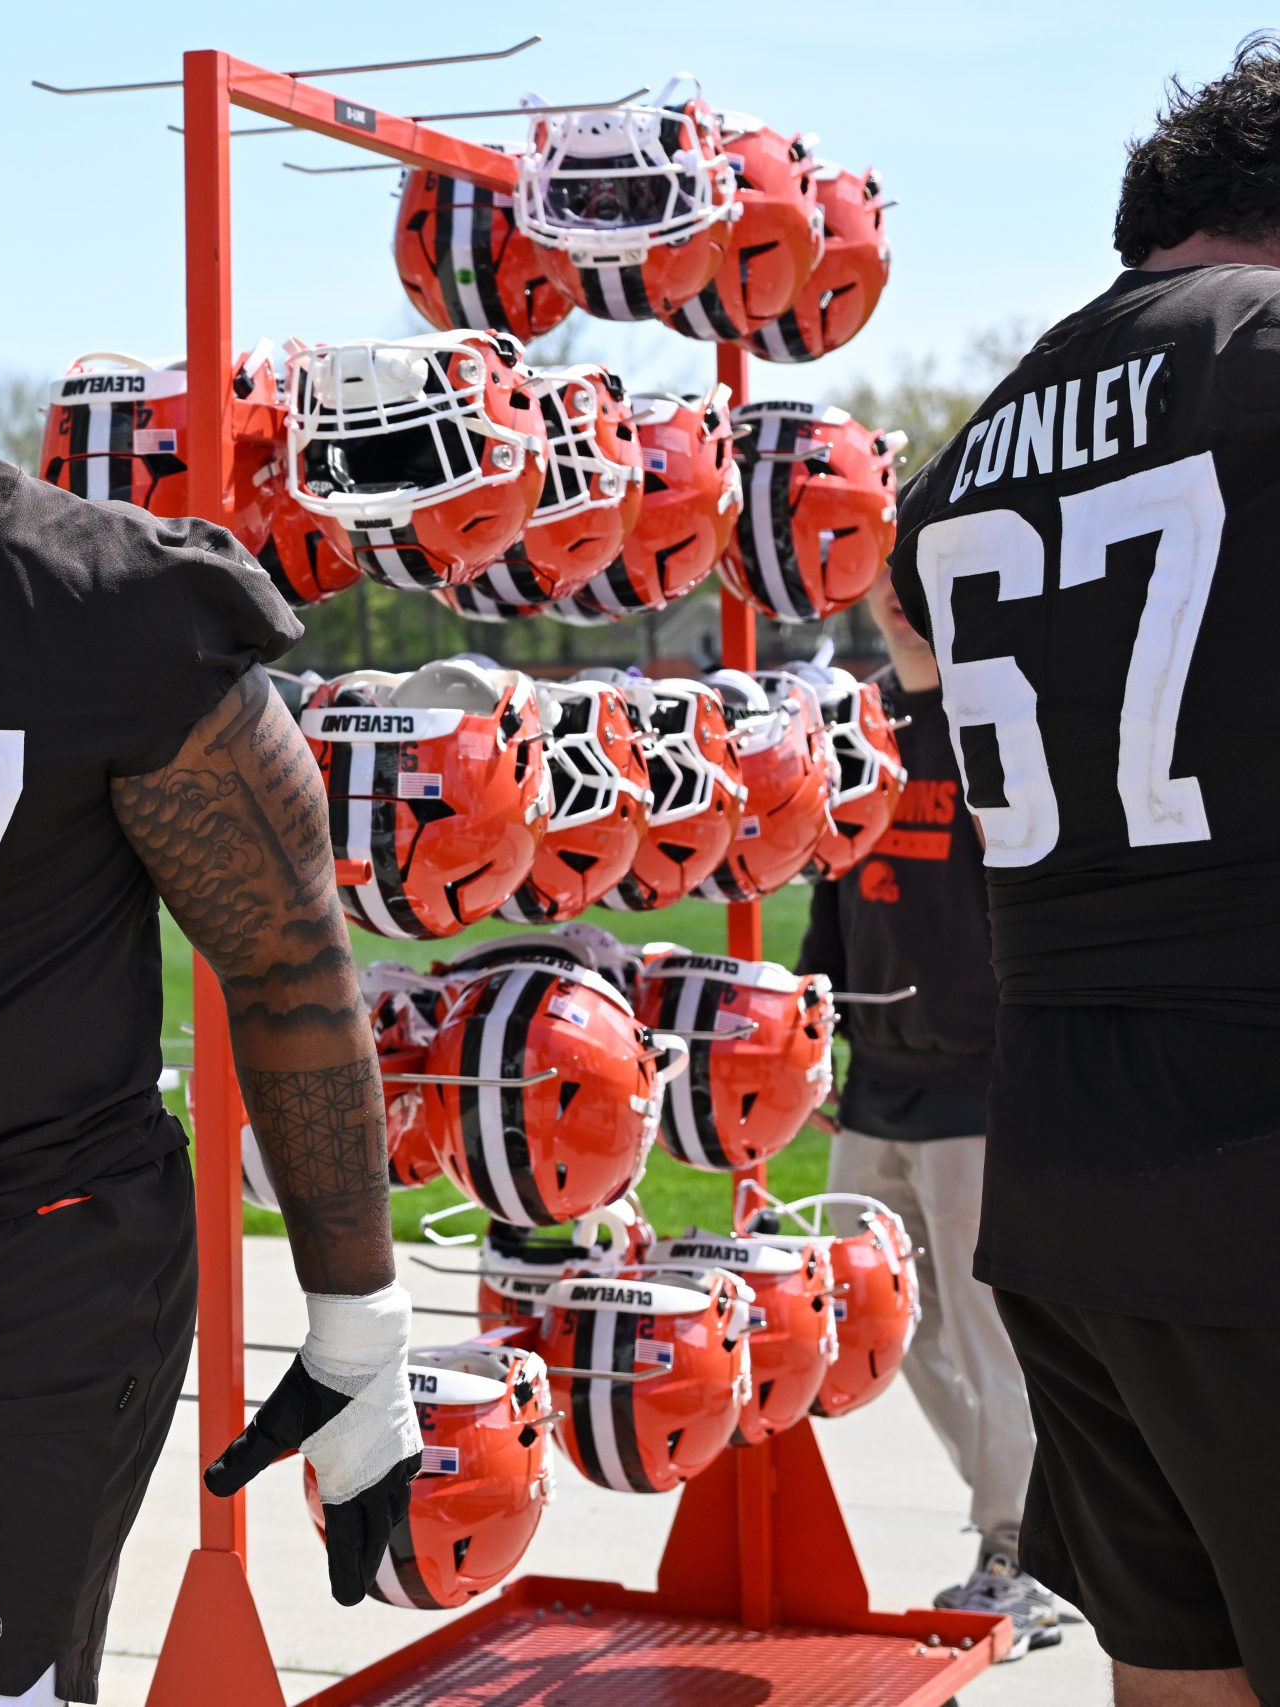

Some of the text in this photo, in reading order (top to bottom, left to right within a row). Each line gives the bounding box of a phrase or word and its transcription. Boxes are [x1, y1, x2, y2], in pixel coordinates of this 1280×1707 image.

[61, 376, 145, 397] CLEVELAND
[949, 353, 1165, 503] CONLEY
[916, 451, 1226, 868] 67
[321, 714, 414, 733] CLEVELAND
[662, 954, 739, 974] CLEVELAND
[670, 1243, 749, 1263] CLEVELAND
[571, 1285, 653, 1306] CLEVELAND
